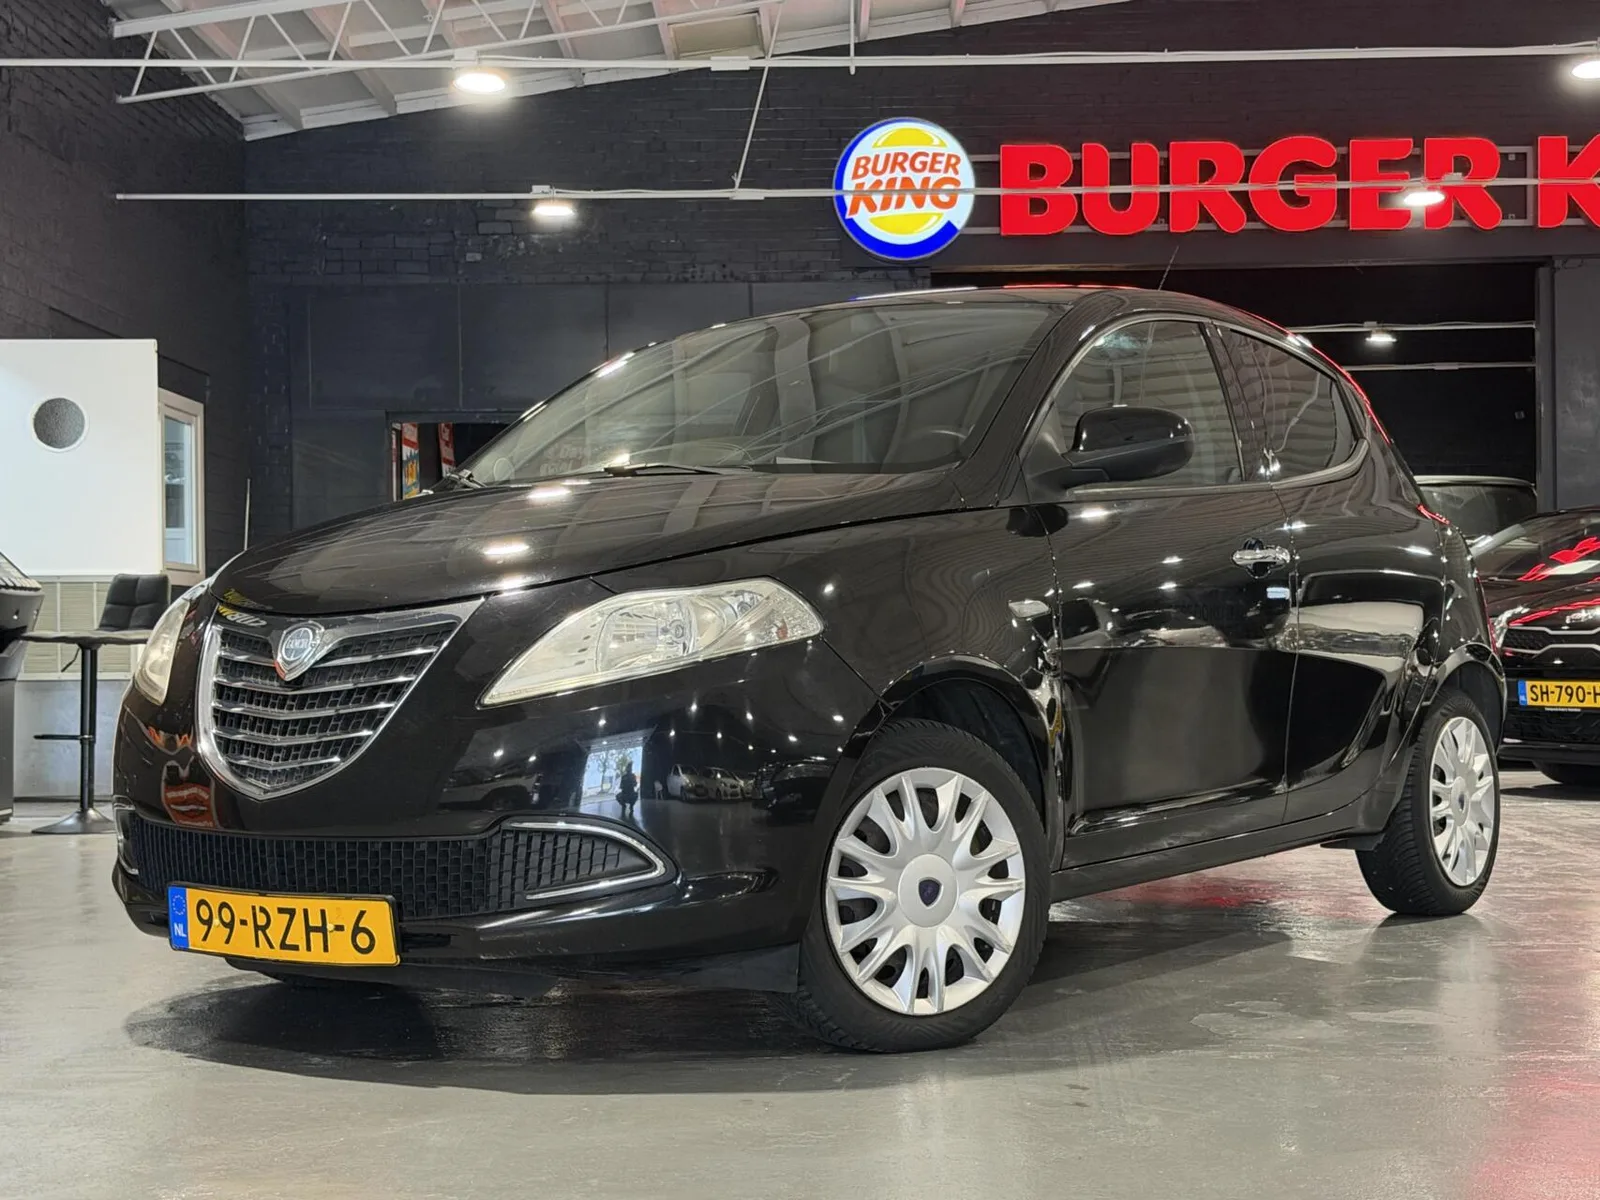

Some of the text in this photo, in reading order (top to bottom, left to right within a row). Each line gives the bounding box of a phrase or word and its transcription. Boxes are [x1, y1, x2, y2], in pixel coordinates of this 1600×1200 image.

[852, 151, 961, 180] BURGER
[848, 176, 961, 217] KING
[1000, 136, 1503, 236] BURGER
[1529, 684, 1600, 704] SH-790-H
[174, 922, 187, 938] NL
[195, 898, 376, 955] 99-RZH-6
